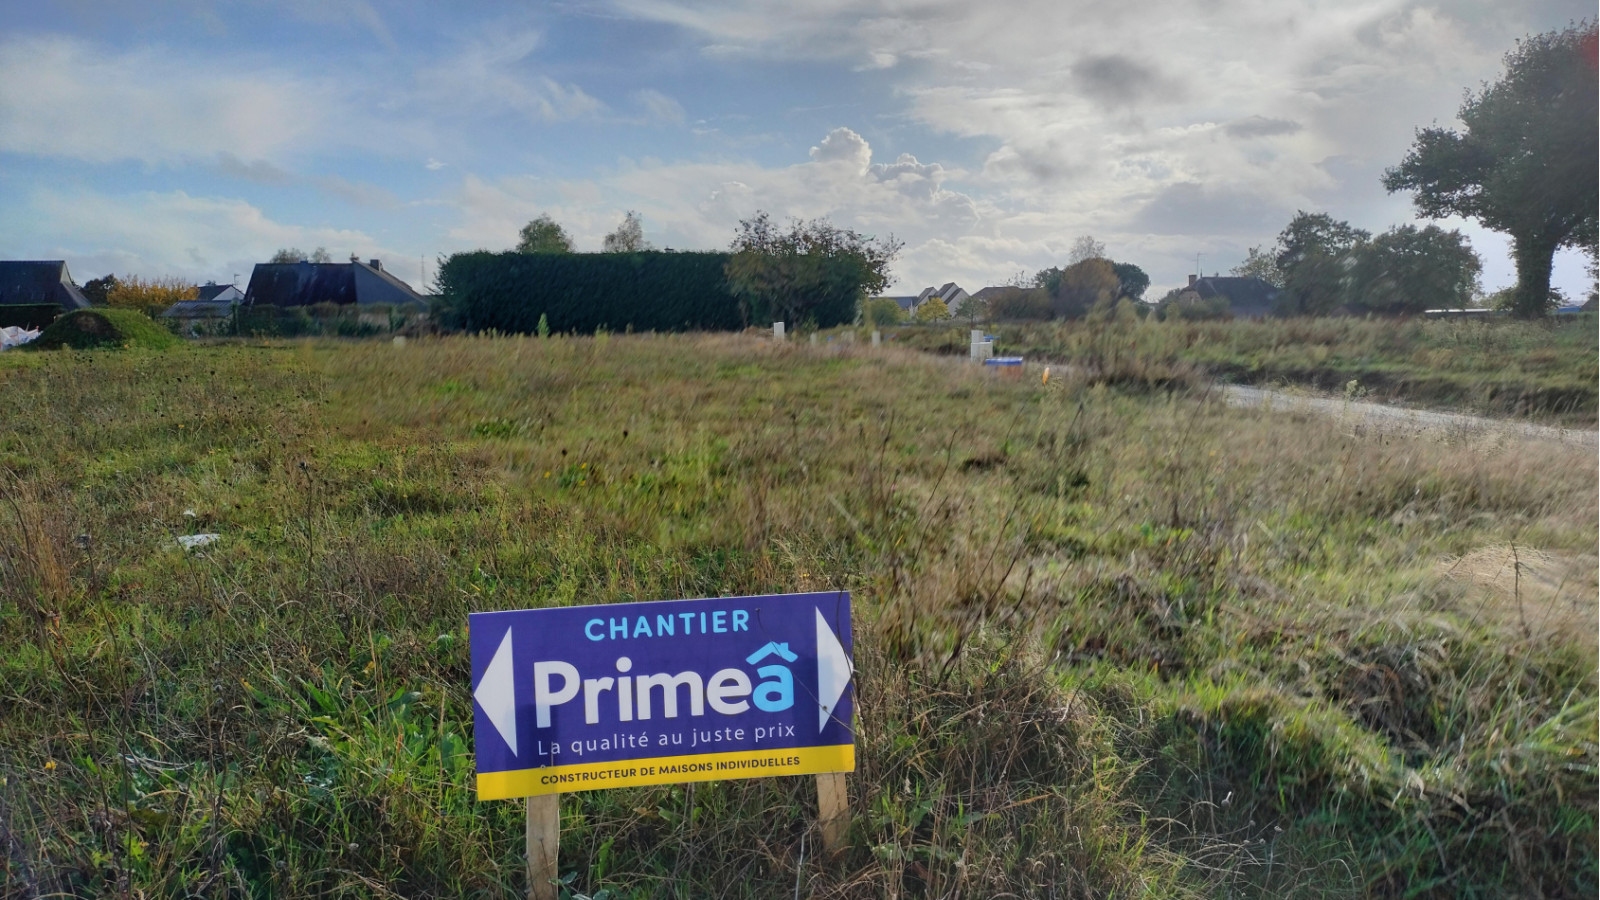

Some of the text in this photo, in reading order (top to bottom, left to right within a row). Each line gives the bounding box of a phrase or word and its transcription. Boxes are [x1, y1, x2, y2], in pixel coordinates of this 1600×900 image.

[584, 609, 749, 641] CHANTIER
[533, 641, 798, 729] Primeâ
[538, 722, 795, 756] La qualité au juste prix
[540, 756, 800, 785] CONSTRUCTEUR DE MAISONS INDIVIDUELLES
